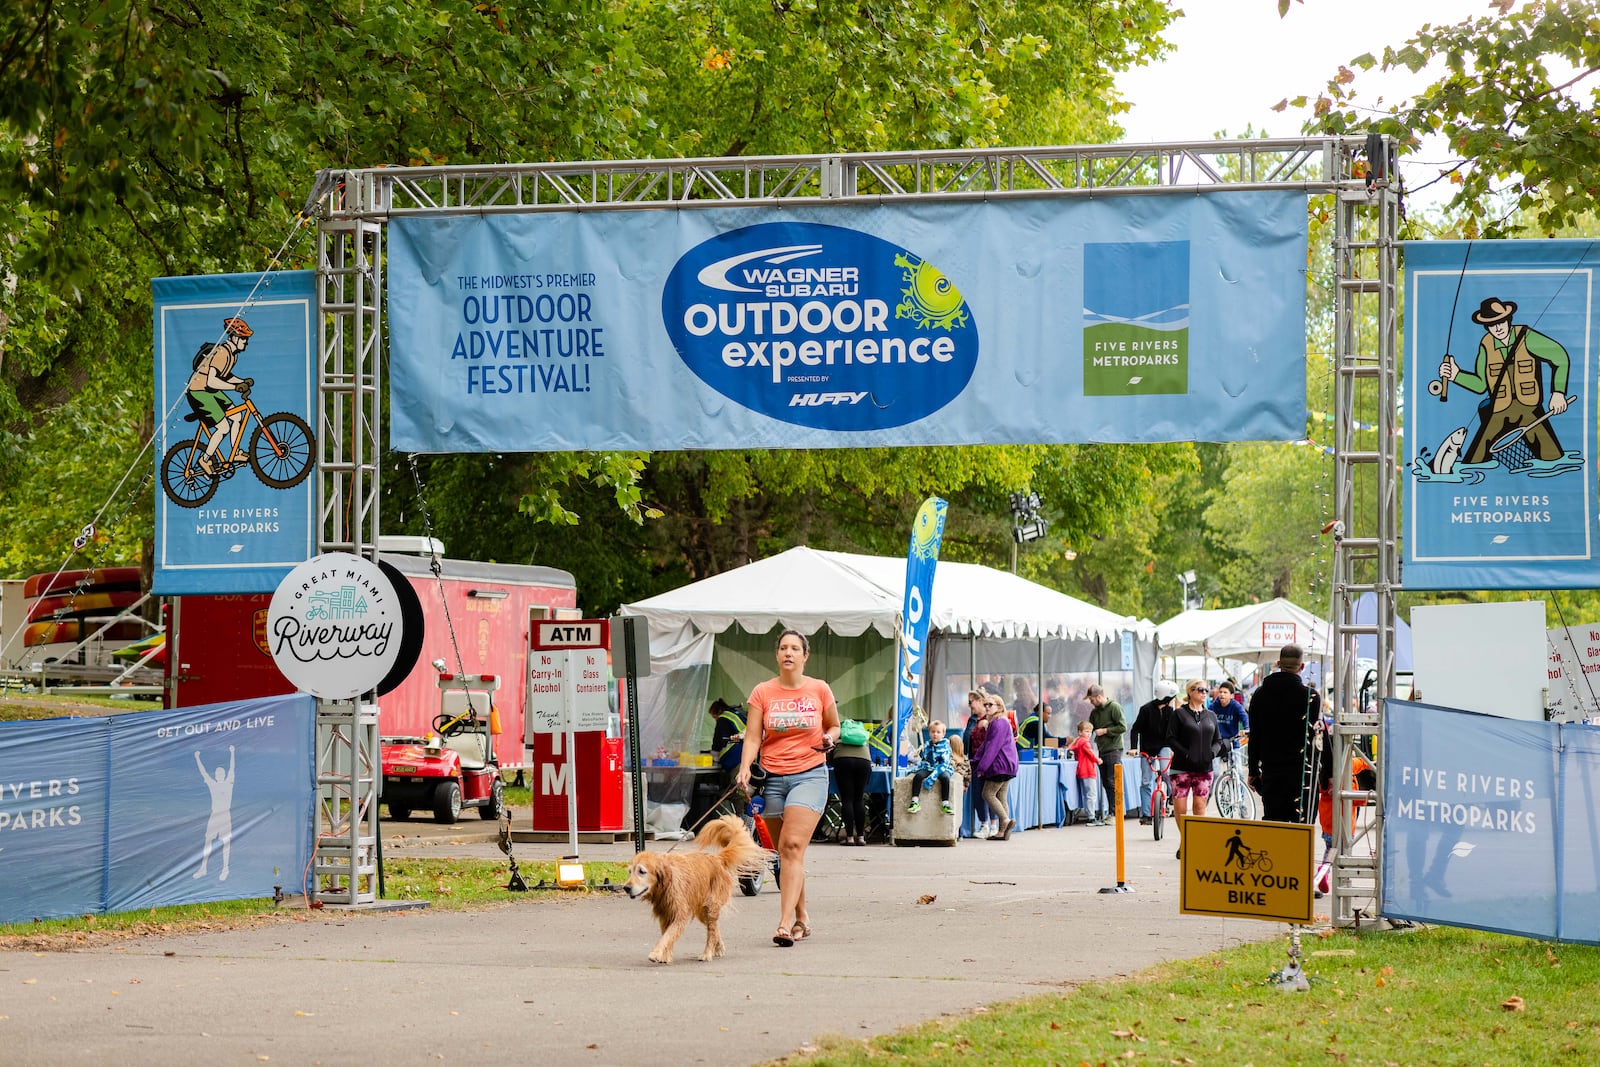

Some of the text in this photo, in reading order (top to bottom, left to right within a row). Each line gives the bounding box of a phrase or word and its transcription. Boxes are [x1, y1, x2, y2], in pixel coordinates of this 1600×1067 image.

[458, 273, 596, 290] THE MIDWEST'S PREMIER
[743, 267, 859, 283] WAGNER
[765, 283, 859, 297] SUBARU
[463, 293, 592, 324] OUTDOOR
[684, 298, 889, 336] OUTDOOR
[451, 328, 605, 359] ADVENTURE
[1095, 340, 1178, 351] FIVE RIVERS
[721, 336, 955, 383] experience
[1093, 354, 1179, 366] METROPARKS
[467, 363, 591, 394] FESTIVAL!
[788, 391, 868, 406] HUFFY
[1453, 495, 1550, 506] FIVE RIVERS
[198, 507, 279, 519] FIVE RIVERS
[1451, 511, 1551, 523] METROPARKS
[196, 522, 279, 534] METROPARKS
[295, 569, 383, 603] GREAT MIAMI
[274, 616, 393, 662] Riverway
[550, 627, 591, 641] ATM
[901, 585, 923, 699] INFO
[541, 655, 551, 664] No
[587, 655, 595, 664] No
[532, 669, 562, 680] Carry-In
[583, 670, 599, 678] Glass
[534, 683, 560, 693] Alcohol
[577, 684, 606, 693] Containers
[772, 701, 814, 711] ALOHA
[536, 710, 560, 718] Thank
[157, 716, 275, 738] GET OUT AND LIVE
[547, 719, 561, 728] You
[769, 718, 816, 728] HAWAII
[1402, 766, 1535, 799] FIVE RIVERS
[1398, 798, 1536, 834] METROPARKS
[1196, 869, 1299, 890] WALK YOUR
[1228, 890, 1266, 906] BIKE
